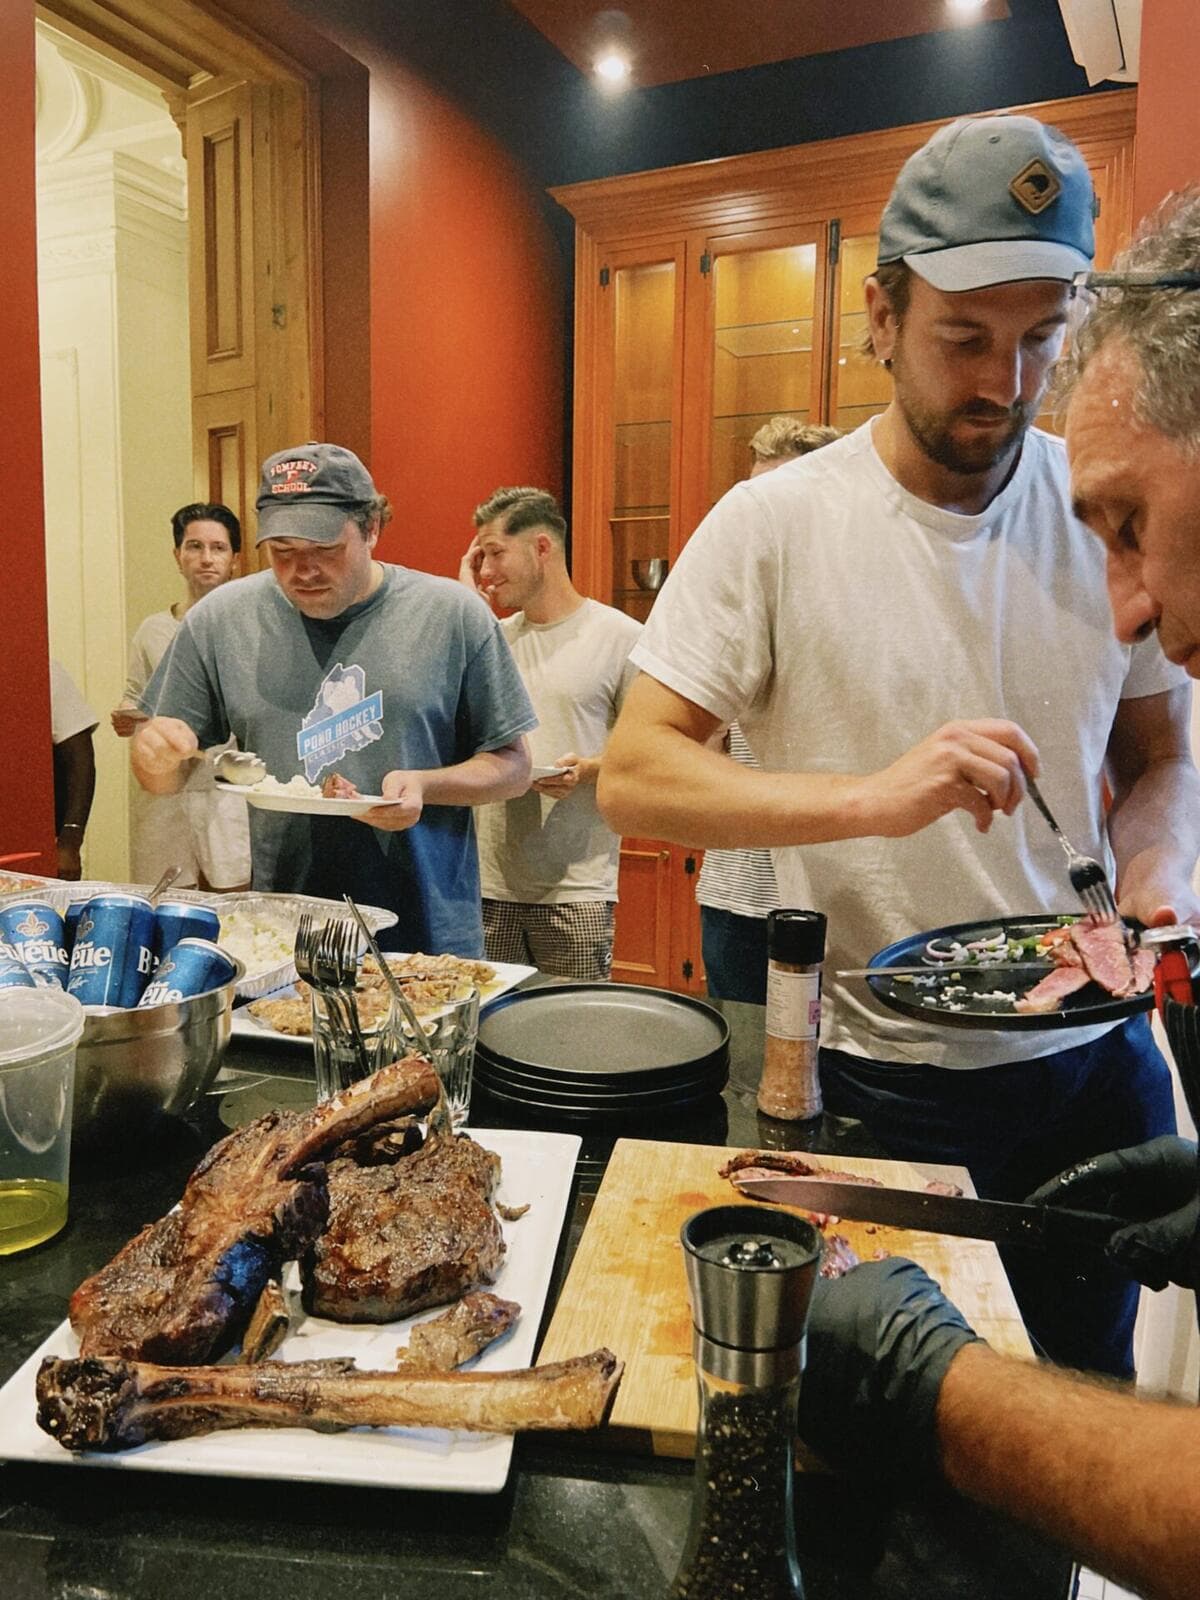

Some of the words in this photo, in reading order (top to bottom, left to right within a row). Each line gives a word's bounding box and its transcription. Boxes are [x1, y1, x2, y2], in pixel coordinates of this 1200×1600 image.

[271, 482, 312, 494] SCHOOL
[303, 728, 332, 753] POND
[336, 705, 377, 738] HOCKEY
